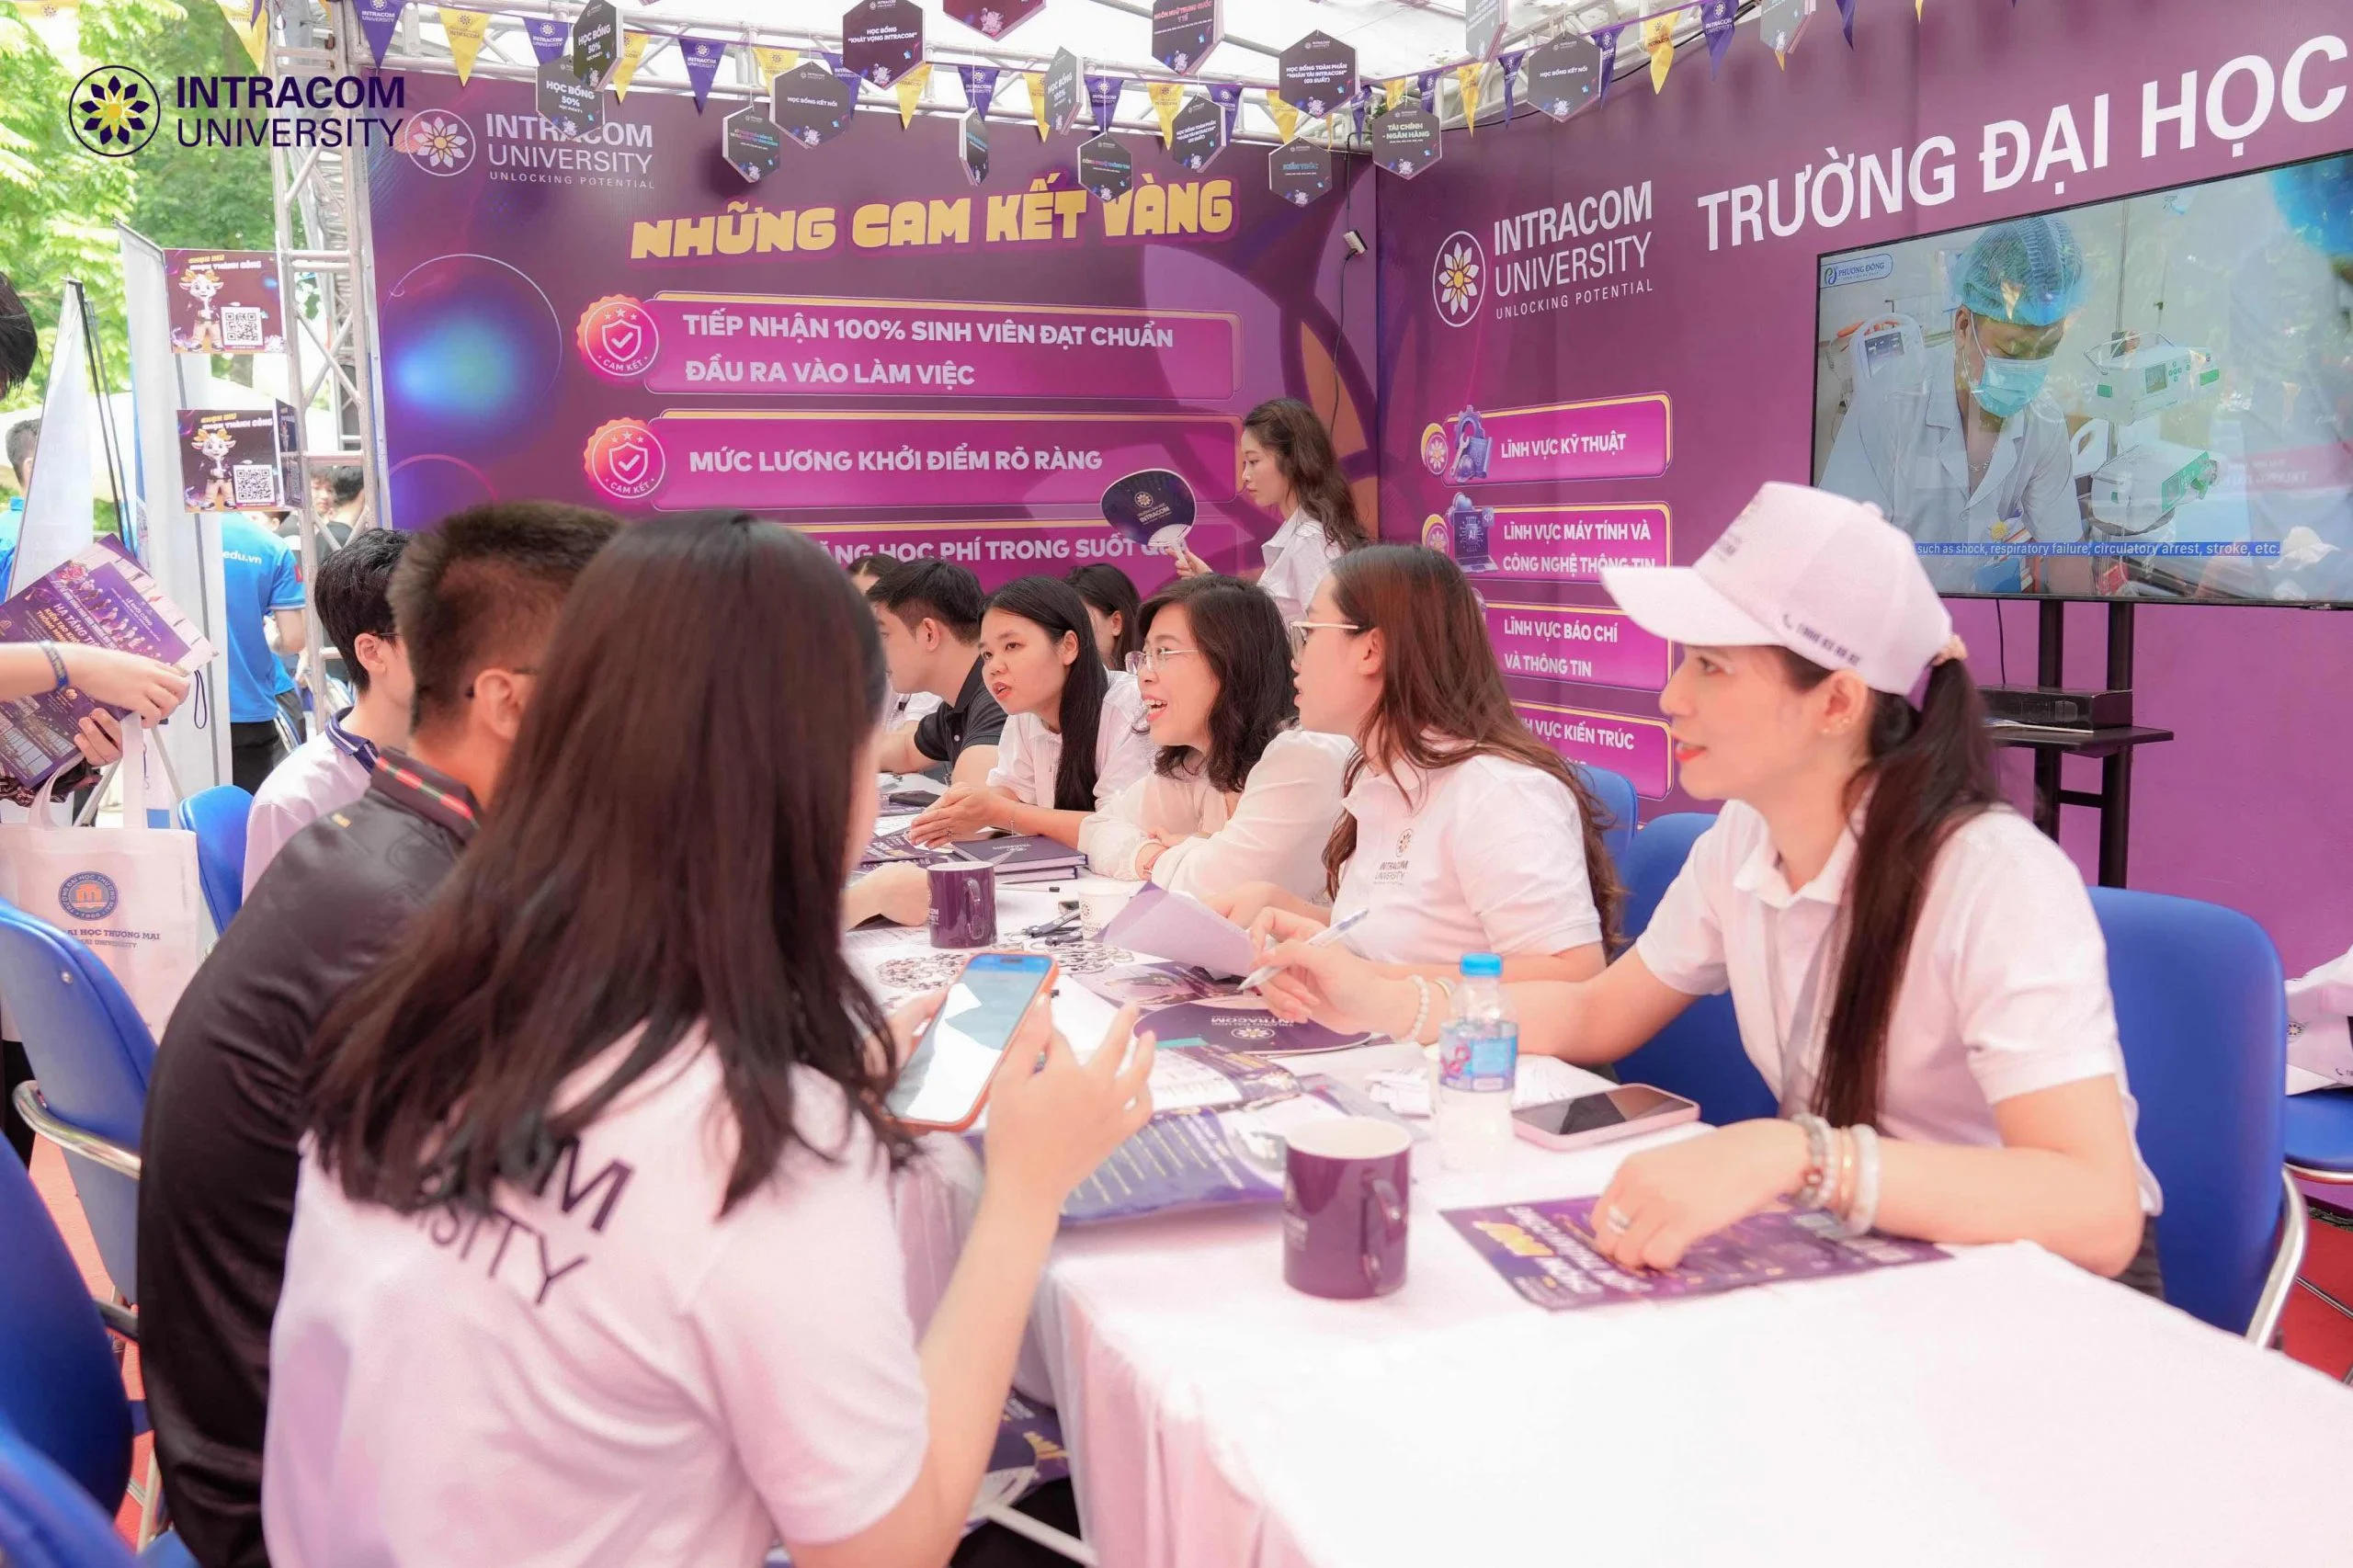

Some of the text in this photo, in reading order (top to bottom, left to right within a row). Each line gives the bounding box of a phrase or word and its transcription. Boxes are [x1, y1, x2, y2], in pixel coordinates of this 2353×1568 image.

[546, 80, 567, 93] HỌC
[561, 96, 580, 108] 50%
[486, 112, 653, 148] INTRCOM
[1697, 35, 2348, 252] TRƯỜNG ĐẠI HỌC
[488, 142, 654, 174] UNIVERSITY
[489, 171, 654, 189] UNLOCKING POTENTIAL
[631, 173, 1233, 259] NHỮNG CAM KẾT VÀNG
[1494, 180, 1653, 256] INTRACOM
[1495, 232, 1653, 298] UNIVERSITY
[1495, 278, 1654, 320] UNLOCKING POTENTIAL
[683, 307, 1175, 351] TIẾP NHẬN 100% SINH VIÊN ĐẠT CHUẨN
[603, 358, 644, 371] CAM KẾT
[686, 353, 975, 391] ĐẦU RA VÀO LÀM VIỆC
[690, 442, 1103, 472] MỨC LƯƠNG KHỞI ĐIỂM RÕ RÀNG
[1501, 429, 1627, 460] LĨNH VỰC KỸ THUẬT
[609, 480, 651, 494] CAM KẾT
[1504, 518, 1652, 544] LĨNH VỰC MÁY TÍNH VÀ
[939, 536, 982, 562] PHÍ
[985, 540, 1071, 561] TRONG
[1075, 531, 1136, 559] SUỐT
[1917, 542, 2280, 557] such as shock, respiratory failure, circulatory arrest, stroke, etc.
[1503, 555, 1540, 572] CÔNG
[1540, 552, 1578, 577] NGHỆ
[1504, 617, 1619, 643] LĨNH VỰC BÁO CHÍ
[1505, 651, 1592, 677] VÀ THÔNG TIN
[1535, 721, 1563, 741] VỰC
[1563, 722, 1596, 744] KIẾN
[1597, 728, 1635, 750] TRÚC
